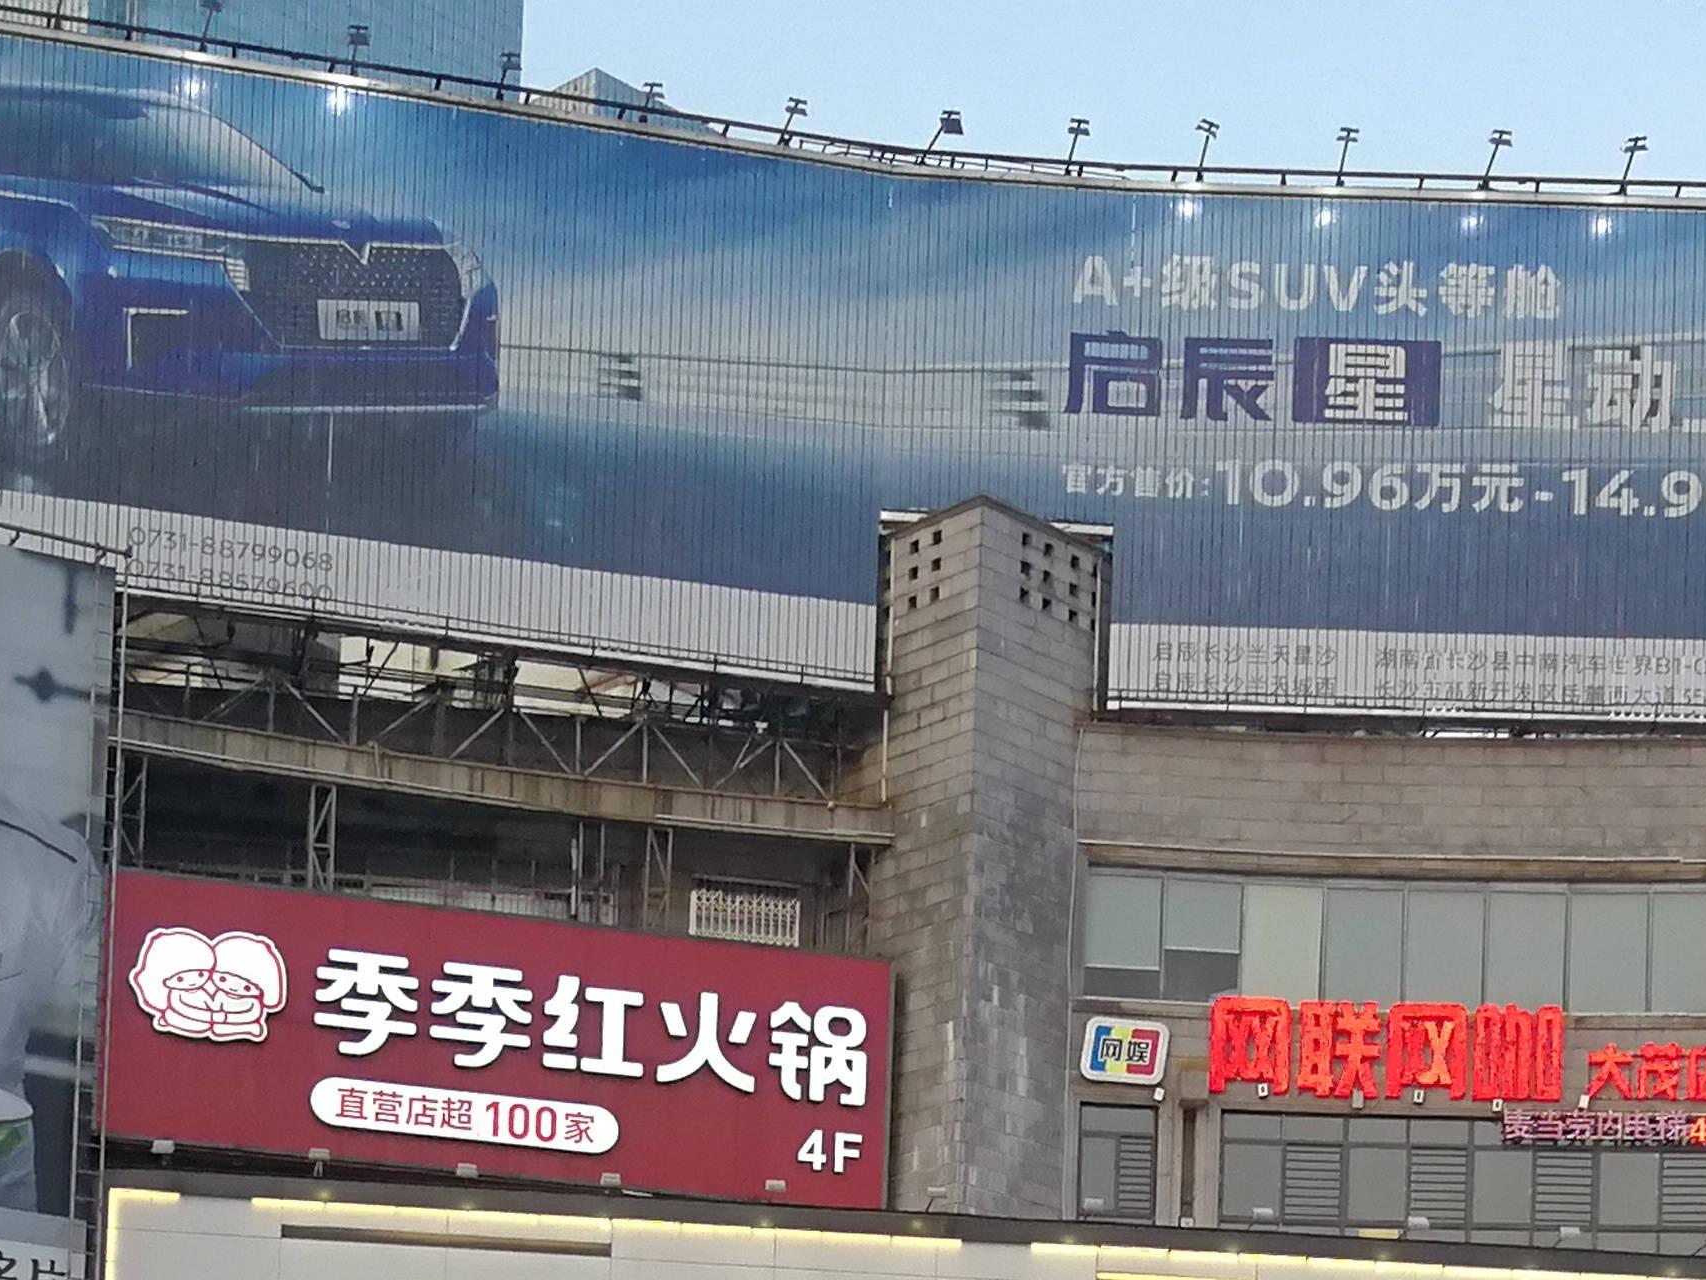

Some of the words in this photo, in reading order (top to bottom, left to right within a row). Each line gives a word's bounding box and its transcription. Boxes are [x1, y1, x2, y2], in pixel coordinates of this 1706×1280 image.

[1073, 254, 1561, 320] A+级SUV头等舱
[314, 947, 869, 1108] 季季红火锅
[1099, 1037, 1151, 1064] 网娱
[1210, 995, 1565, 1102] 网联网咖
[335, 1088, 595, 1144] 直营店超100家
[797, 1129, 863, 1175] 4F
